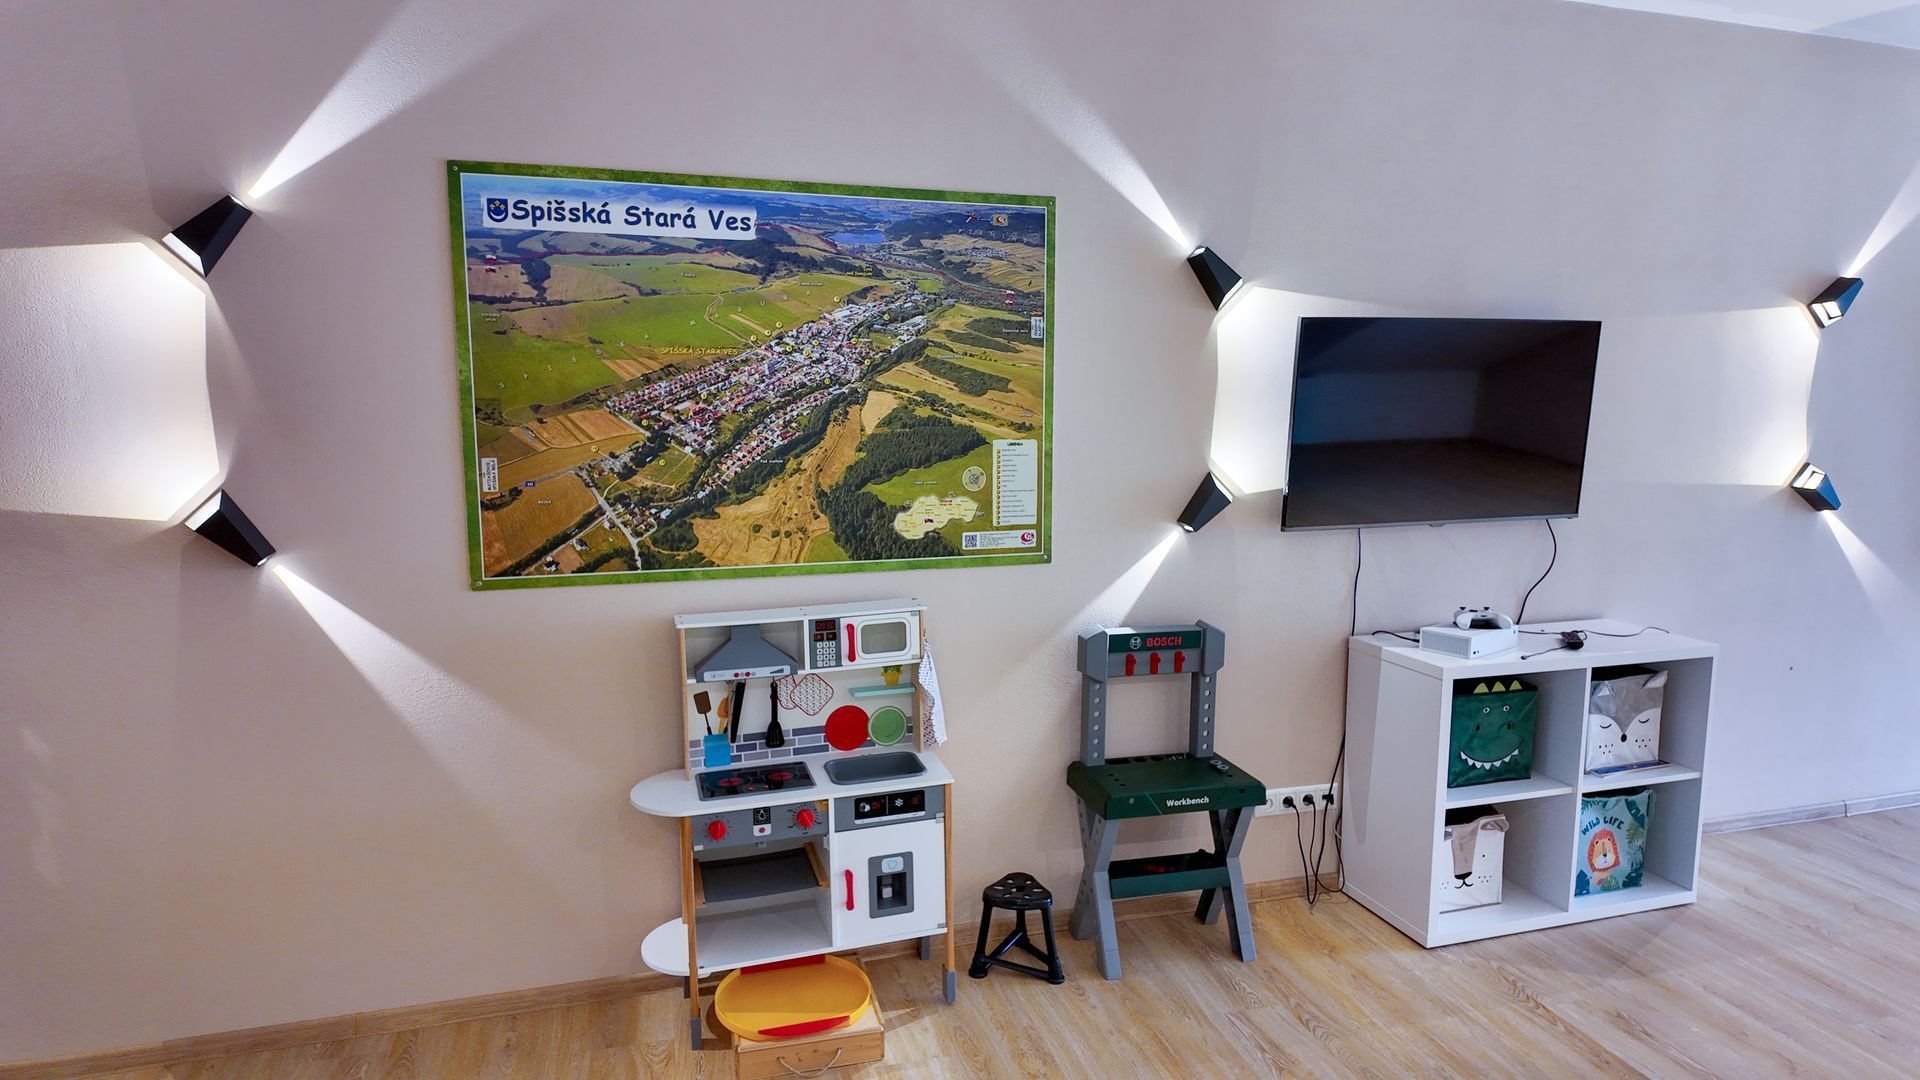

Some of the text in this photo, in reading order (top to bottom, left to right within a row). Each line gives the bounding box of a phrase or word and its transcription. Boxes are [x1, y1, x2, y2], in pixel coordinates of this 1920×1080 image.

[511, 199, 752, 232] Spišská Stará Ves
[696, 346, 721, 355] STARÁ
[723, 348, 738, 356] VES
[1146, 636, 1182, 647] BOSCH
[1166, 796, 1209, 807] Workbench
[1581, 816, 1625, 835] WILD LIFE
